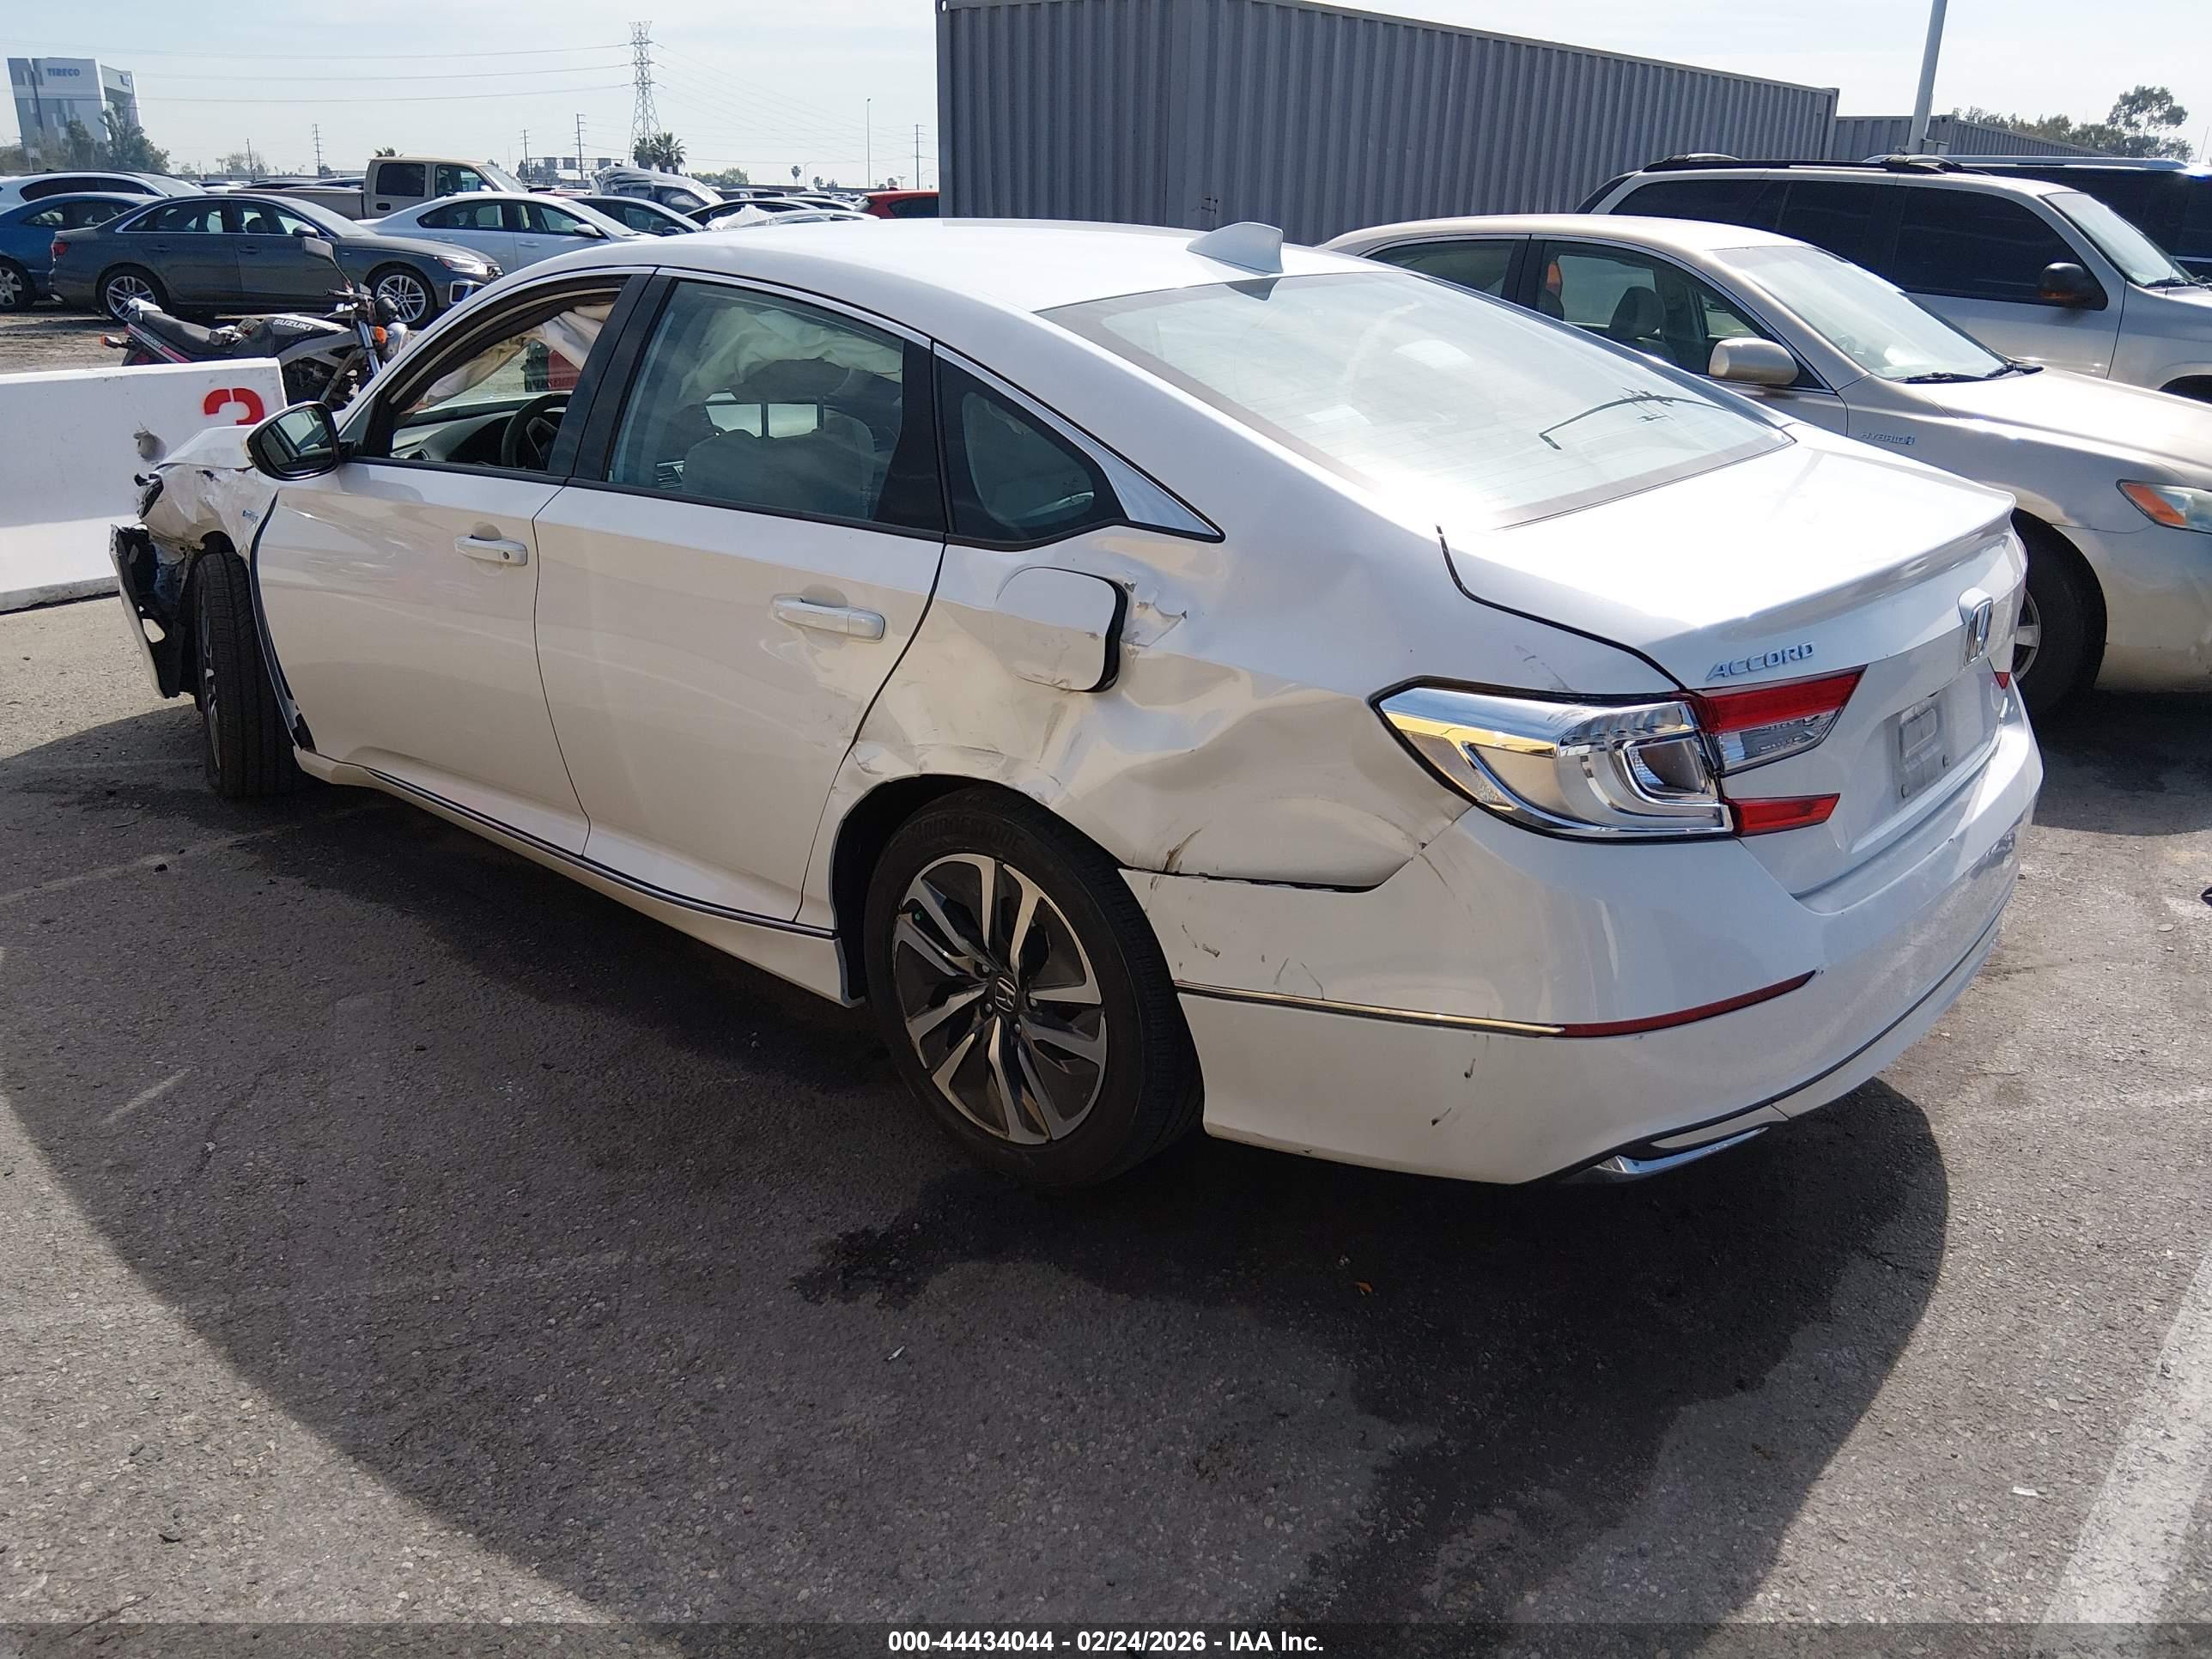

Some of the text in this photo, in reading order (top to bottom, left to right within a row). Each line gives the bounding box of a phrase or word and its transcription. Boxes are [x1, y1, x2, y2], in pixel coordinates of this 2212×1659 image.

[46, 68, 81, 77] TIRECO
[272, 319, 313, 331] SUZUKI
[1705, 641, 1814, 682] ACCORD
